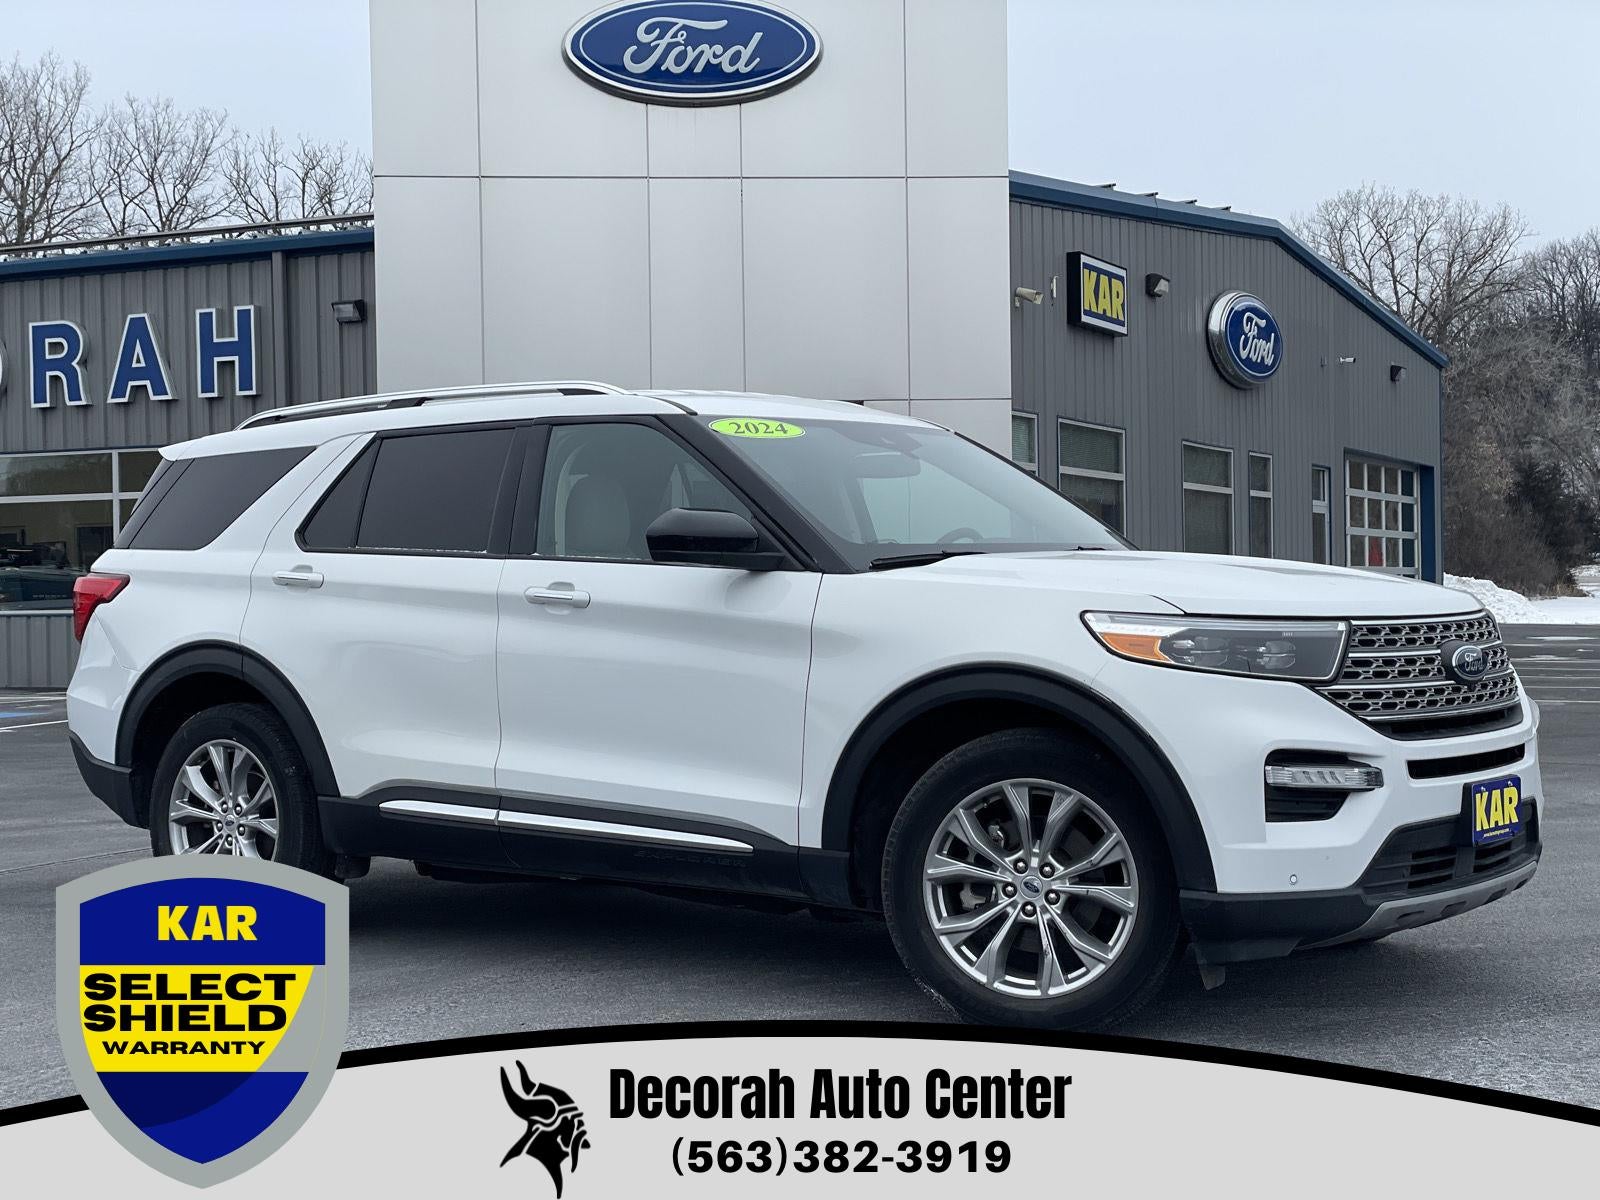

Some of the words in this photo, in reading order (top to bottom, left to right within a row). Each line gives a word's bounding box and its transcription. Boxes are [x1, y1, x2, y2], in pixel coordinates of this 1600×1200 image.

[622, 16, 764, 75] Ford
[1083, 268, 1125, 321] KAR
[0, 304, 258, 409] RAH
[1239, 311, 1275, 366] Ford
[728, 422, 789, 434] 2024
[1464, 652, 1484, 672] Ford
[1475, 786, 1519, 832] KAR
